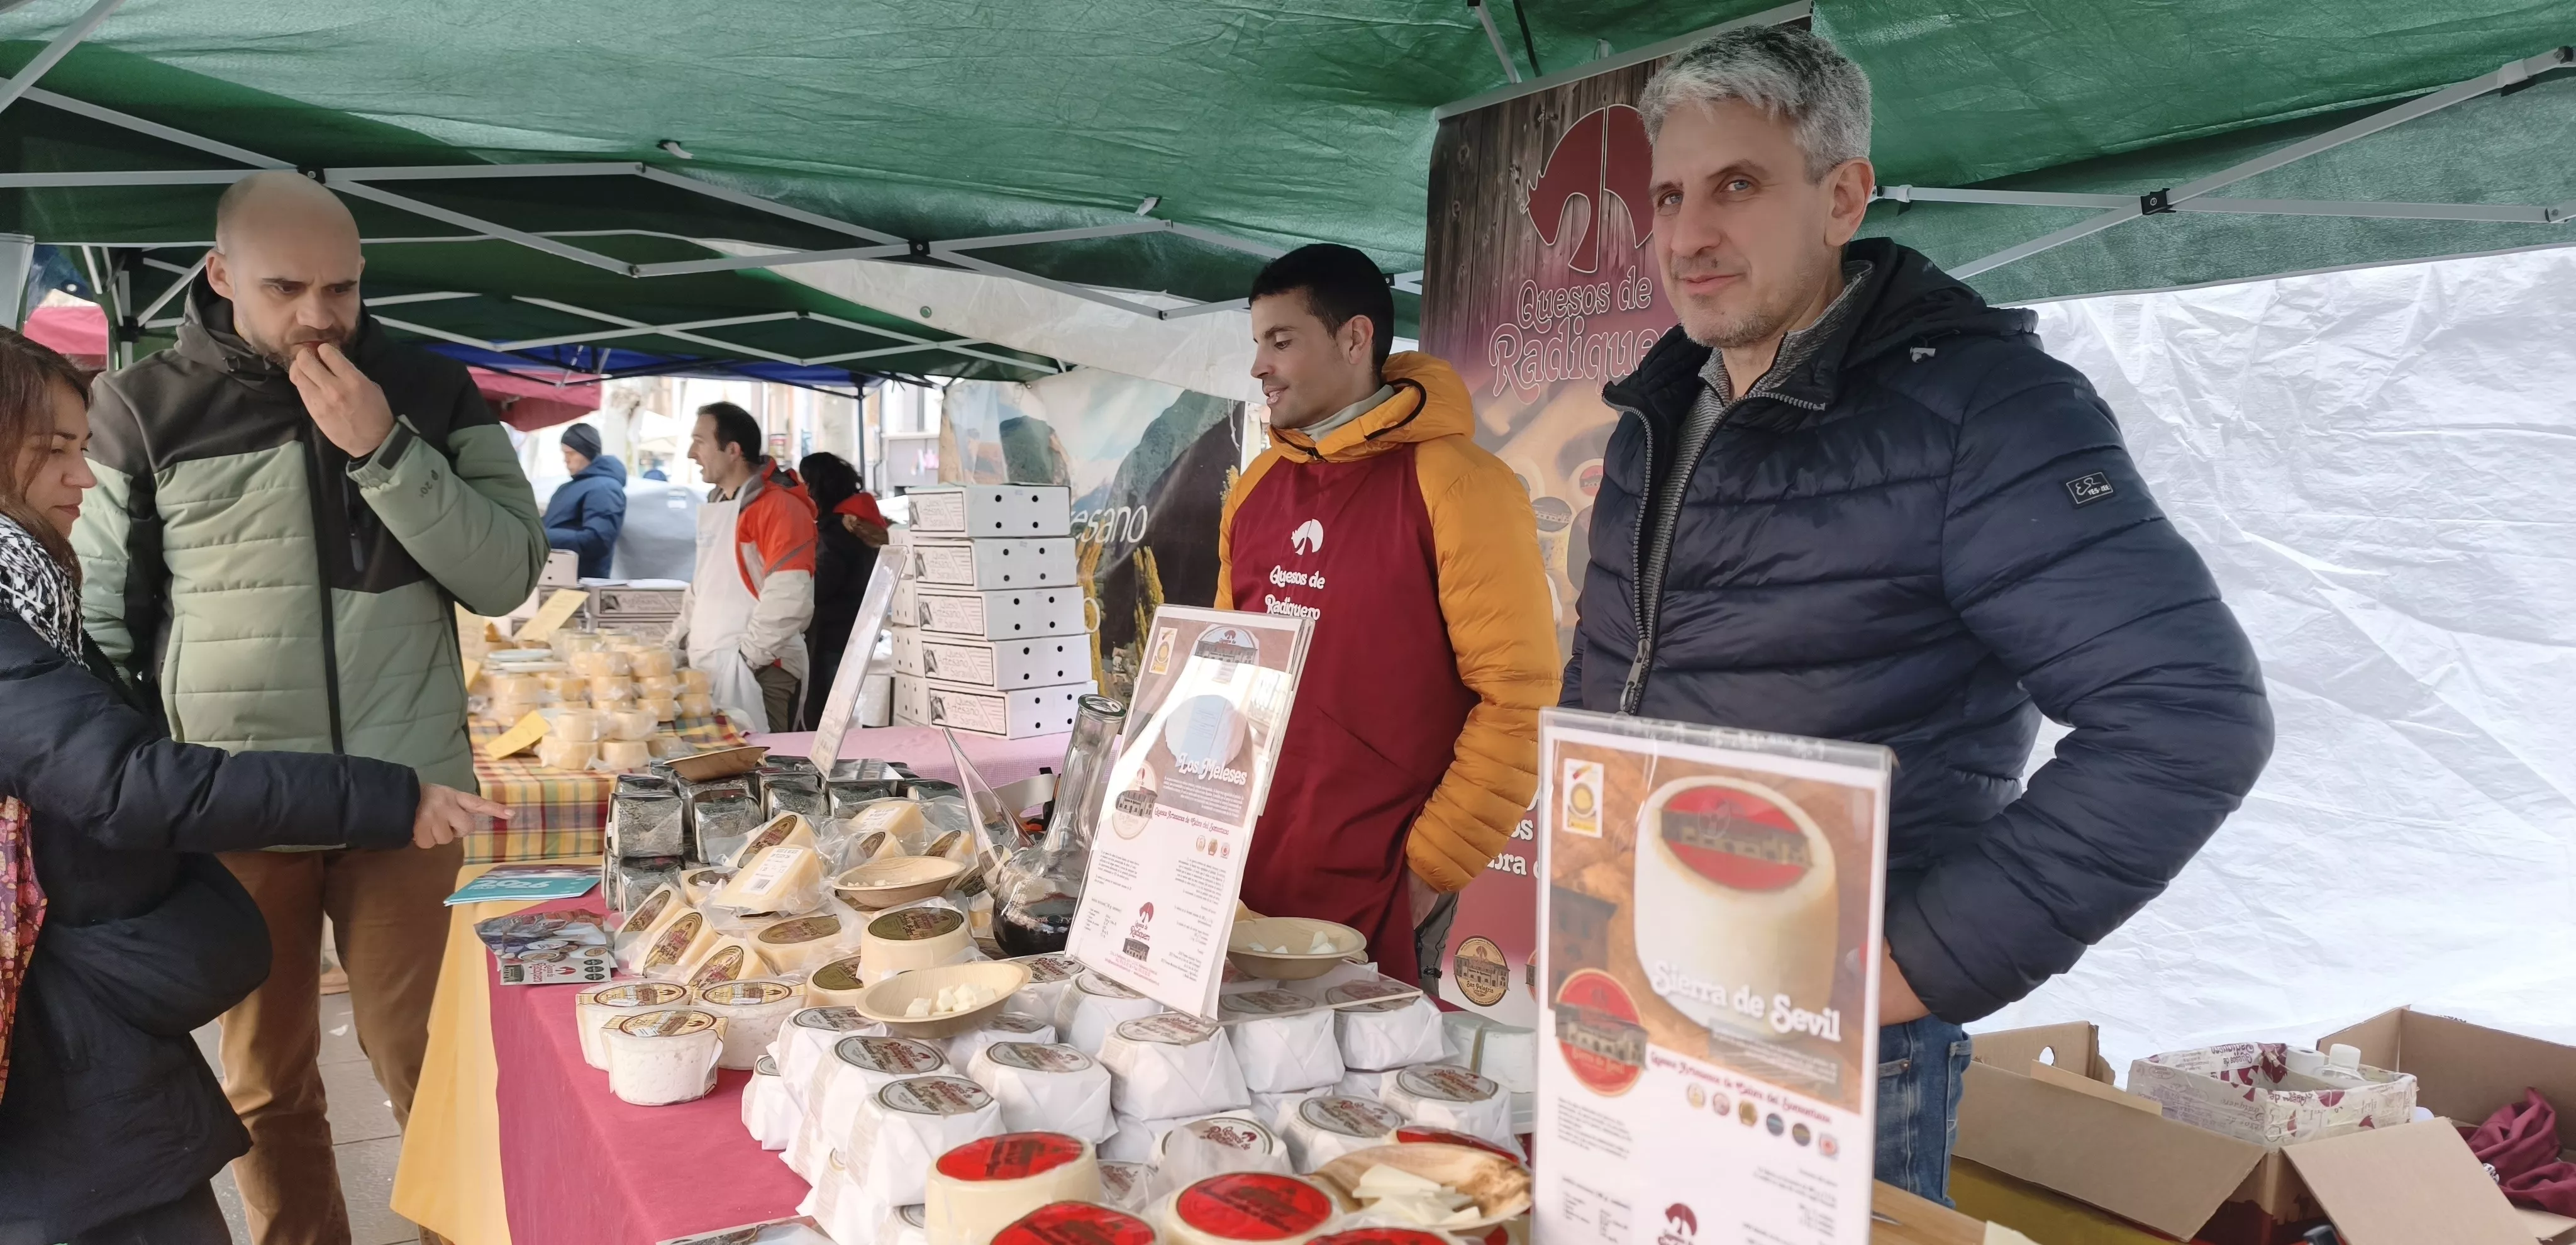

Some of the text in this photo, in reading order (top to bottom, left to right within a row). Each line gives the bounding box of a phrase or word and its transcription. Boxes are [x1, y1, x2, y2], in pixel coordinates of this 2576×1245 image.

[1518, 265, 1652, 333] Quesos de
[1070, 505, 1148, 544] esano
[1270, 565, 1326, 589] Quesos de
[1265, 594, 1321, 620] Radiquero
[1176, 752, 1247, 785] Los Meleses
[1652, 959, 1841, 1042] Sierra de Sevil
